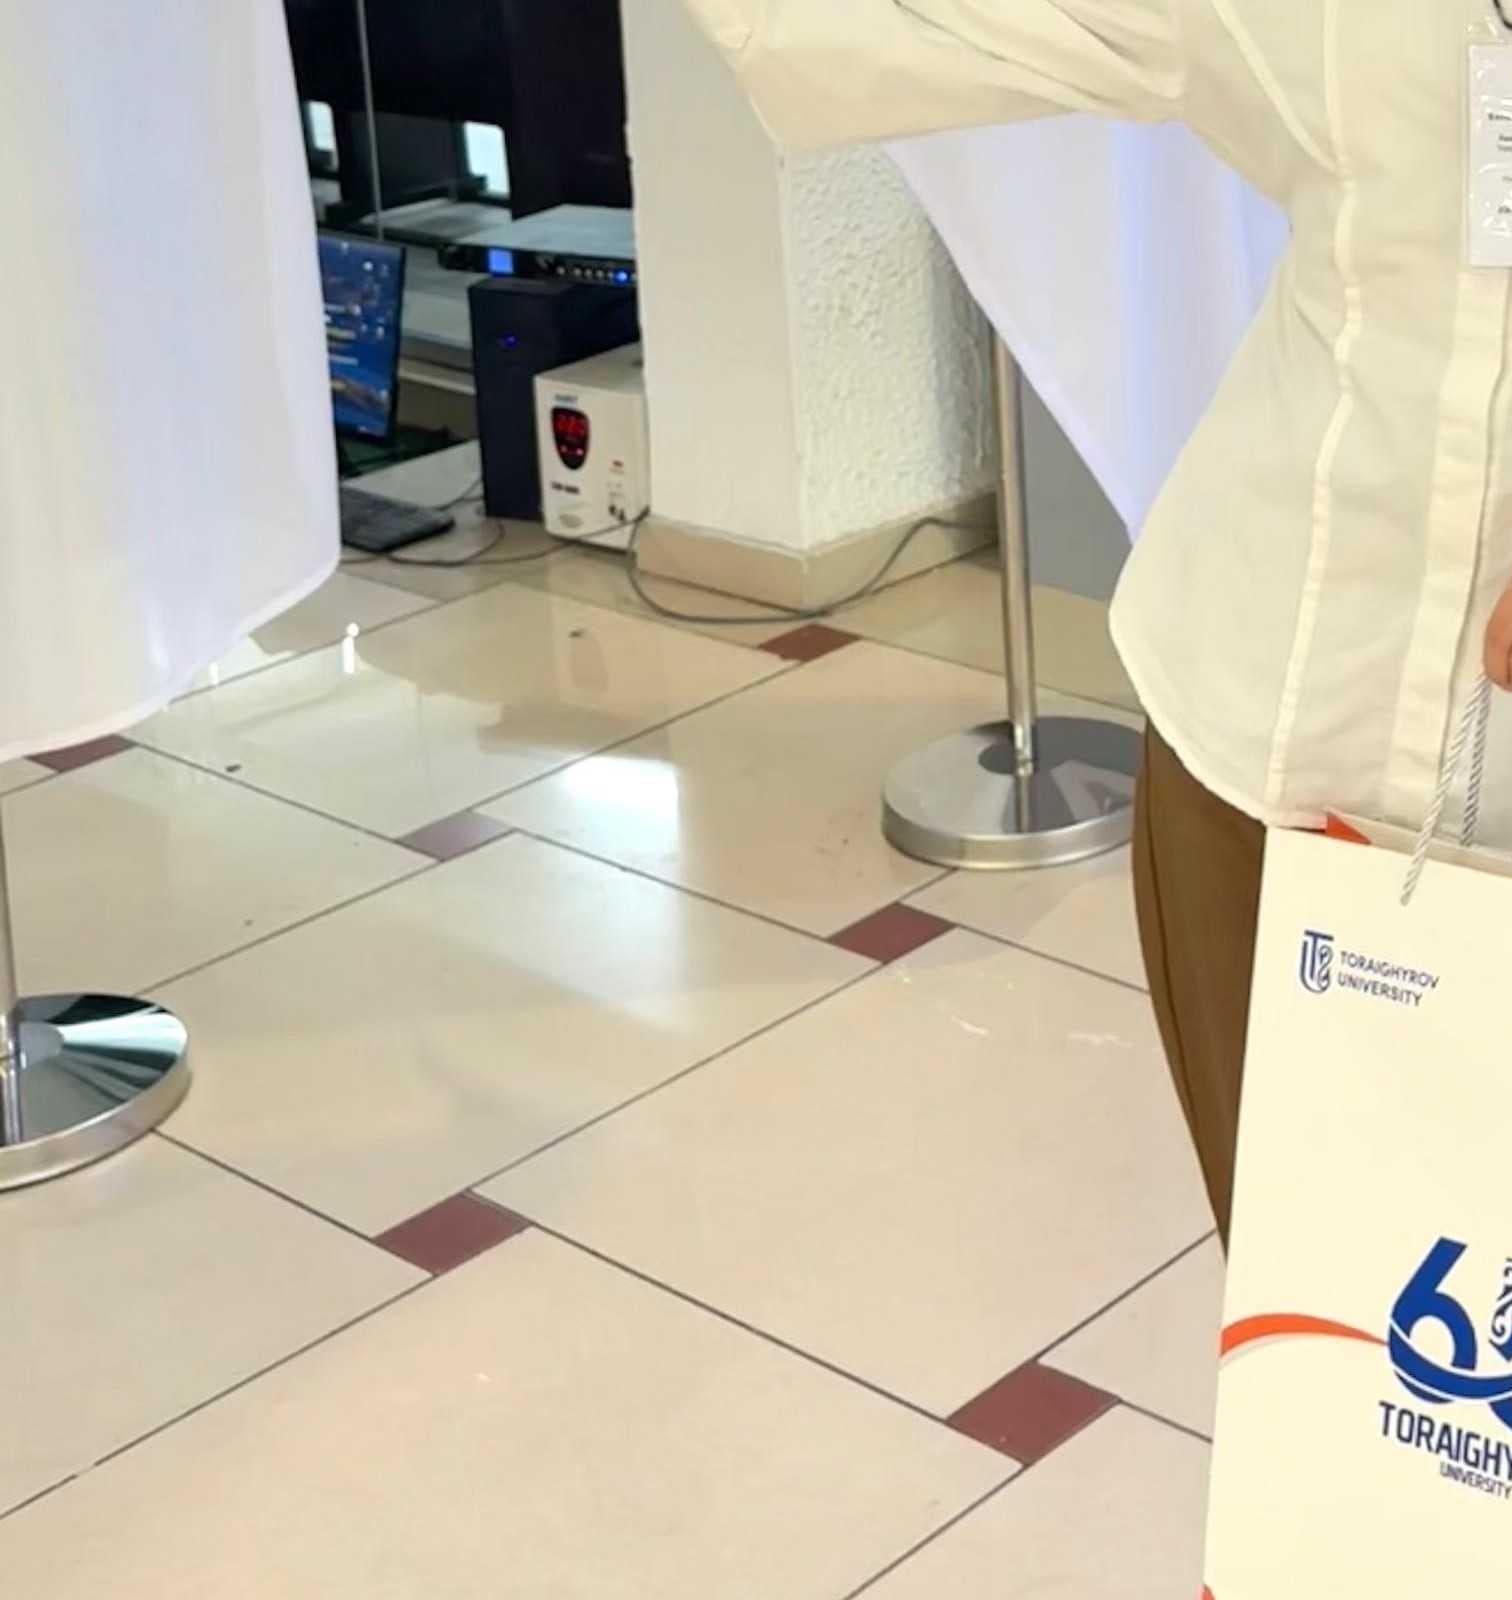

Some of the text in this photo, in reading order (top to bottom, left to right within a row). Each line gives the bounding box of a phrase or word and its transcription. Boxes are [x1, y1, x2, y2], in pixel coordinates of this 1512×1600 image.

[1337, 971, 1423, 1007] UNIVERSITY
[1339, 950, 1440, 989] TORAIGHYROV
[1438, 1460, 1512, 1501] UNIVERSITY
